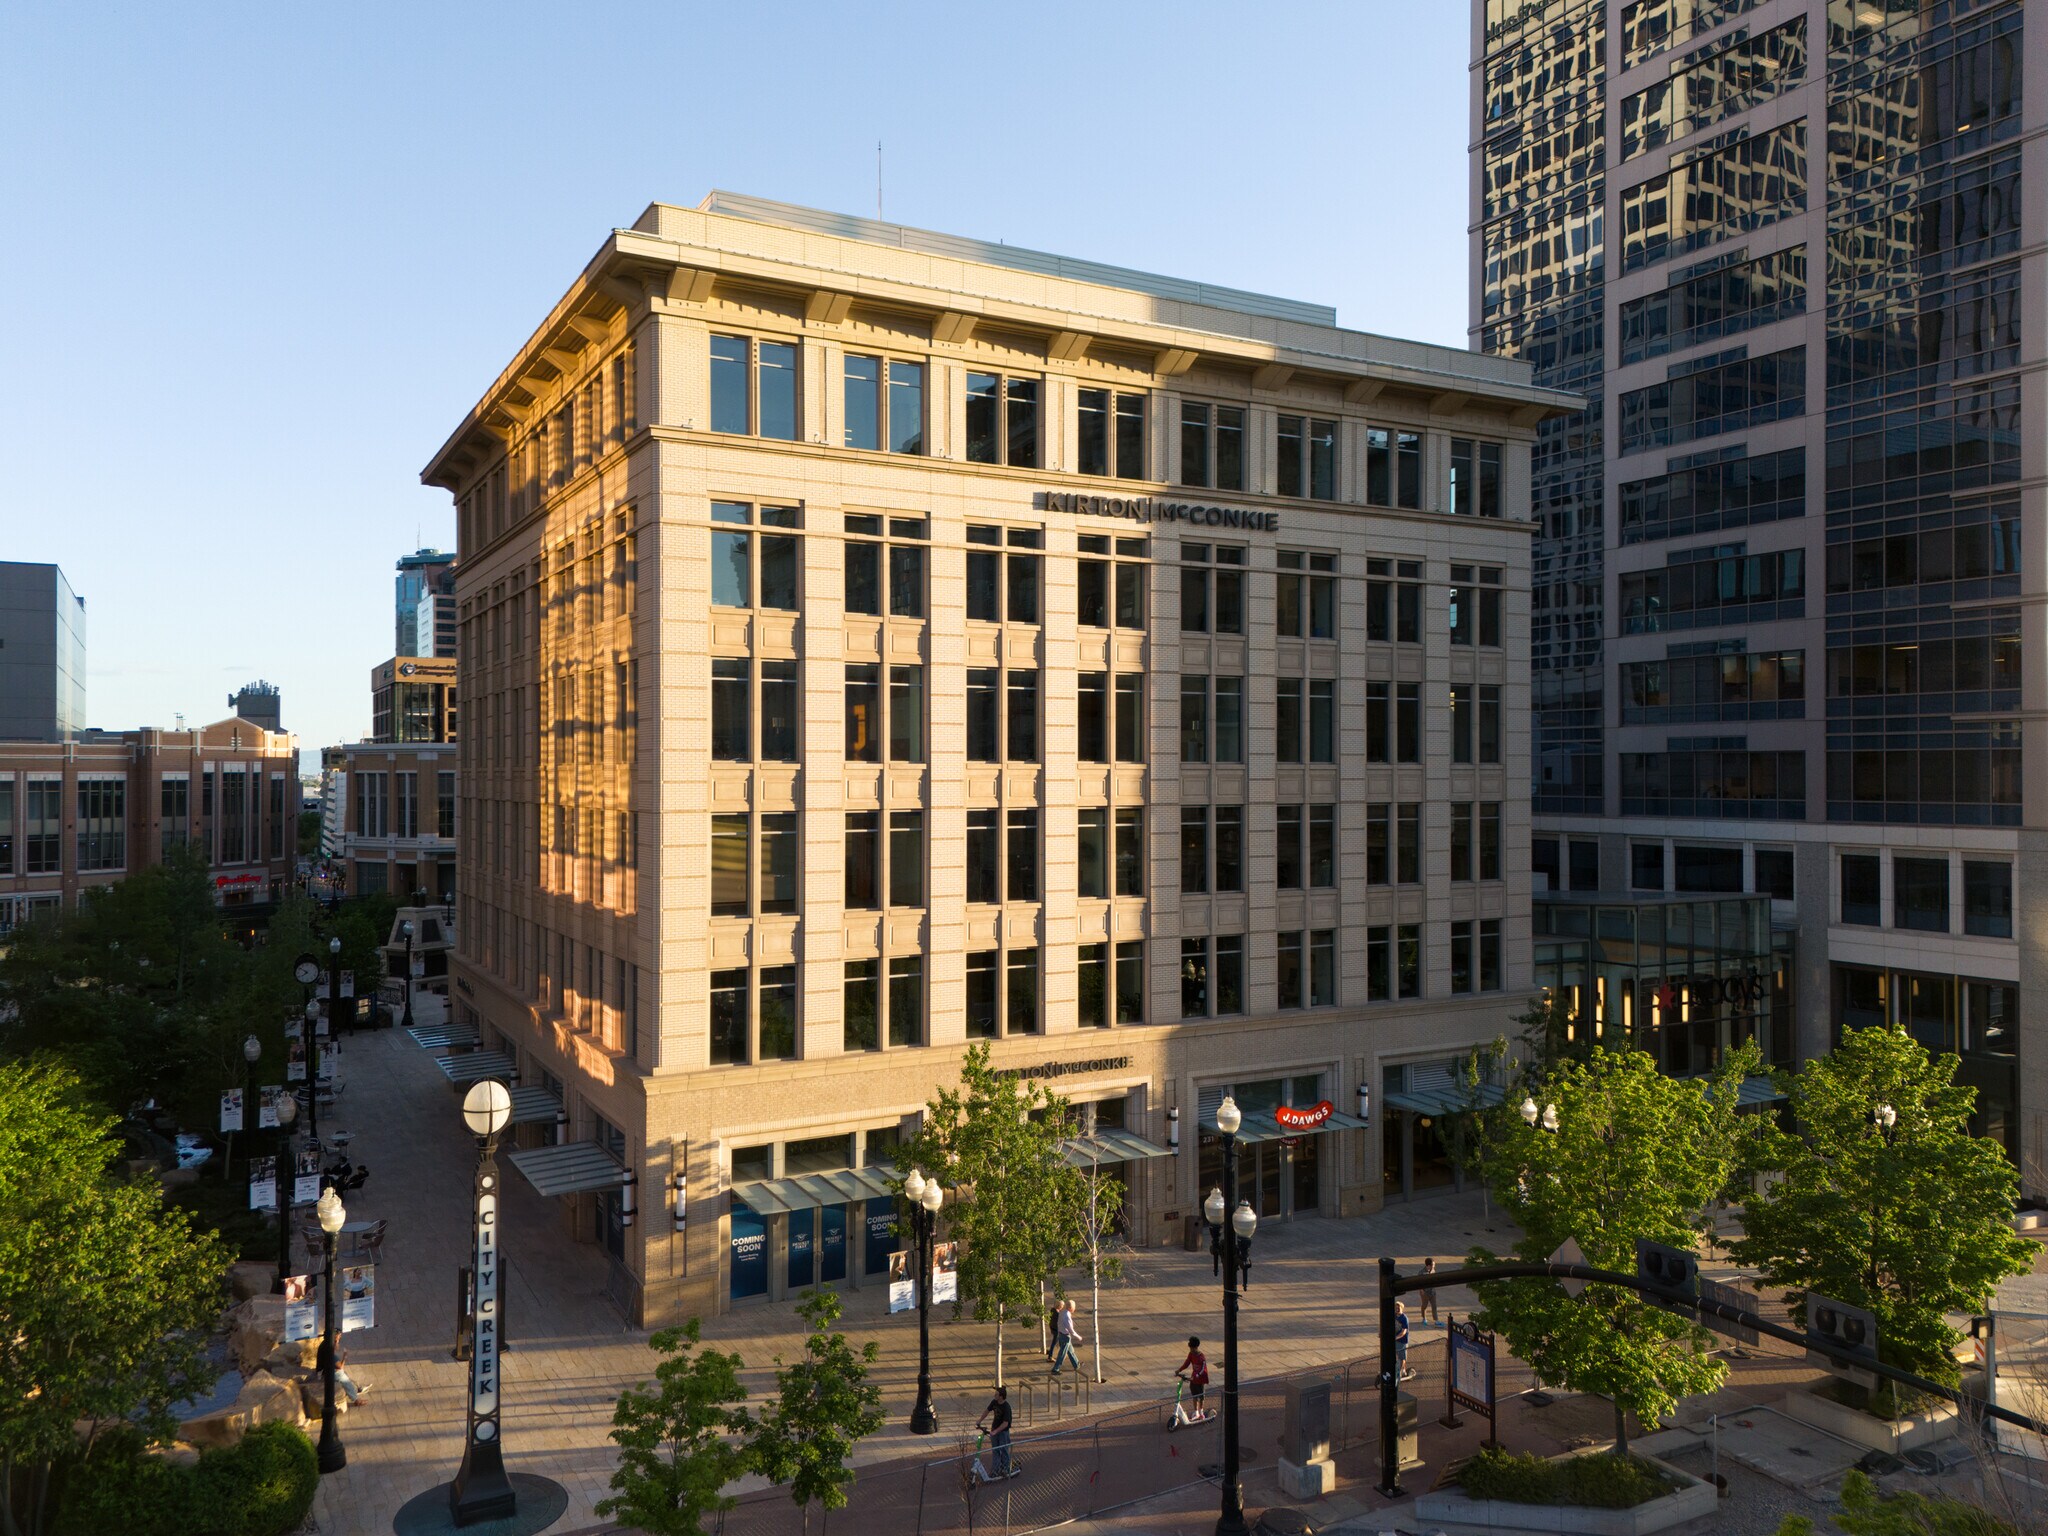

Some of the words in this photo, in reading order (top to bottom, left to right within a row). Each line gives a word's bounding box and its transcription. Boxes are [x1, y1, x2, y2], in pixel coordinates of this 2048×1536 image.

[1046, 491, 1144, 519] KIRTON
[997, 1063, 1053, 1083] ITON
[1282, 1106, 1329, 1125] J.DAWGS
[866, 1213, 898, 1225] COMING
[480, 1210, 494, 1286] CITY
[731, 1234, 766, 1246] COMING
[737, 1243, 761, 1253] SOON
[479, 1298, 494, 1395] CREEK
